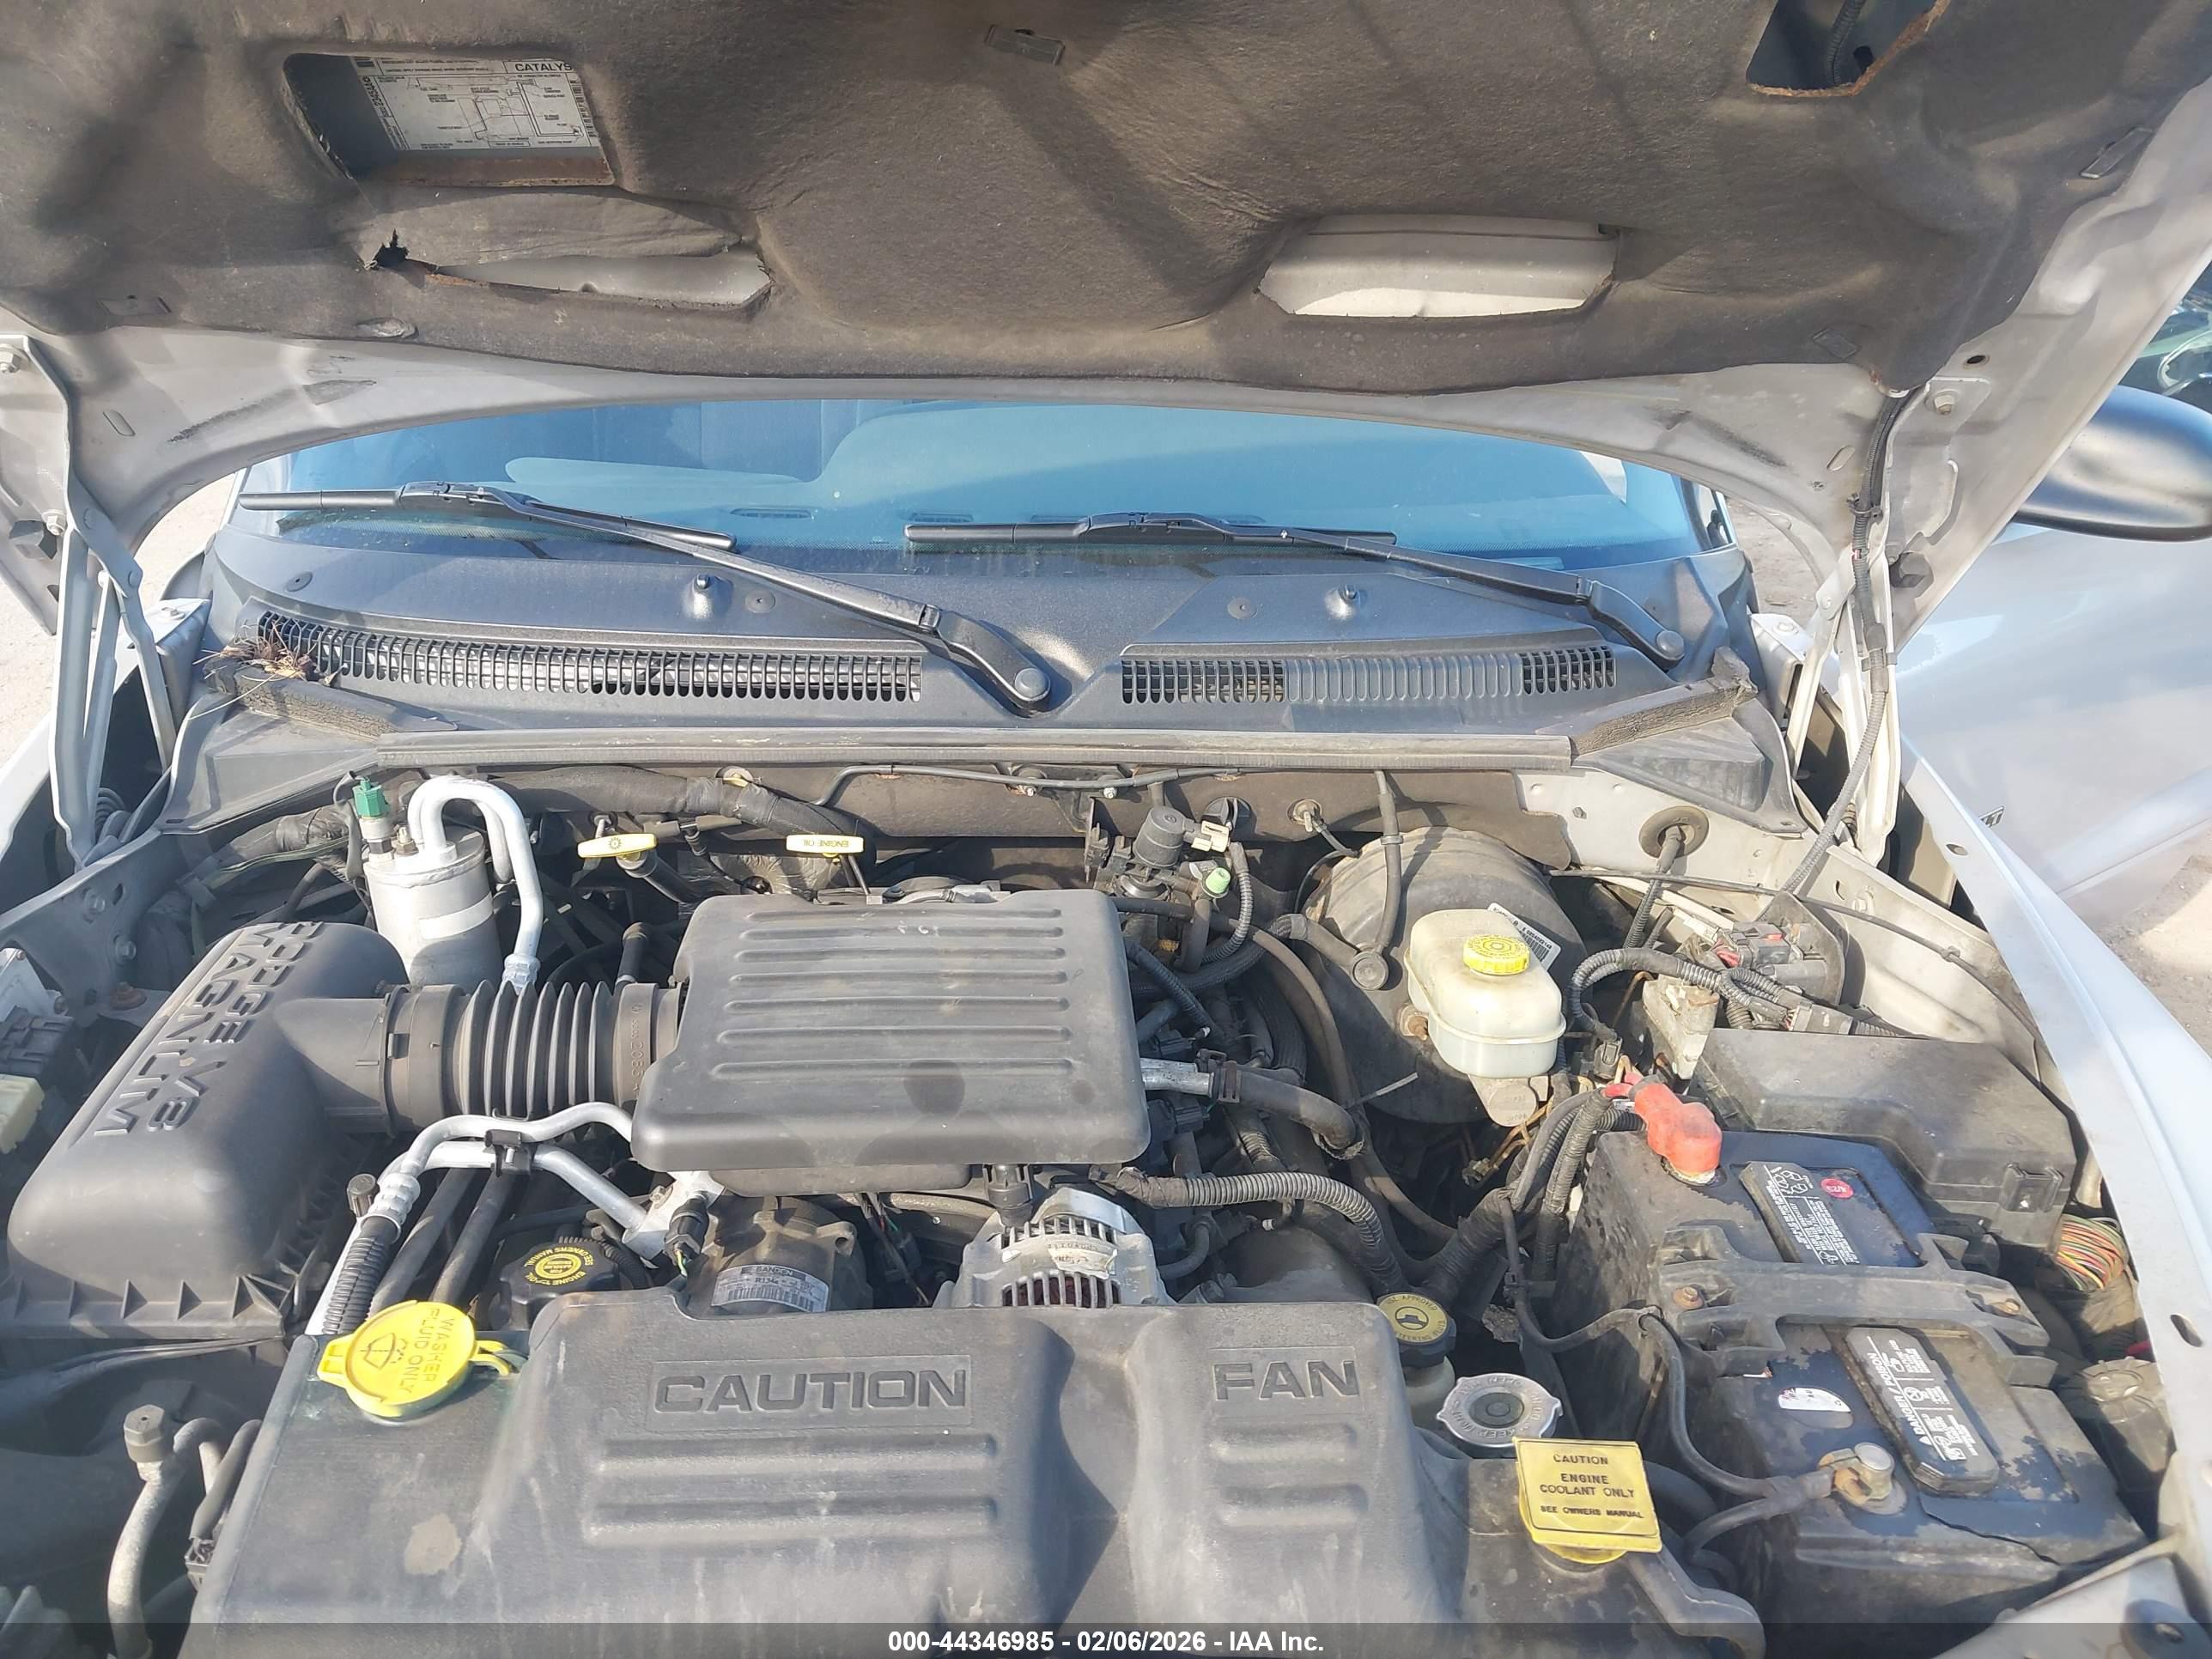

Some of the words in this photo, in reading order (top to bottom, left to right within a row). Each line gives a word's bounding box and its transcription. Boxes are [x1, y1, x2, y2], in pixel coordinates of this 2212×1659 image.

[202, 920, 325, 1045] DODGE
[94, 921, 285, 1138] MAGNUM
[146, 1060, 227, 1132] V8
[413, 1307, 441, 1352] FLUID
[421, 1316, 457, 1383] WASHER
[398, 1352, 425, 1395] ONLY
[653, 1368, 968, 1415] CAUTION
[1212, 1358, 1360, 1403] FAN
[1553, 1454, 1609, 1466] CAUTION
[1560, 1473, 1610, 1485] ENGINE
[1540, 1484, 1596, 1497] COOLANT
[1602, 1487, 1636, 1498] ONLY
[1540, 1504, 1559, 1514] SEE
[1562, 1506, 1602, 1516] OWNERS
[1606, 1509, 1645, 1519] MANUAL
